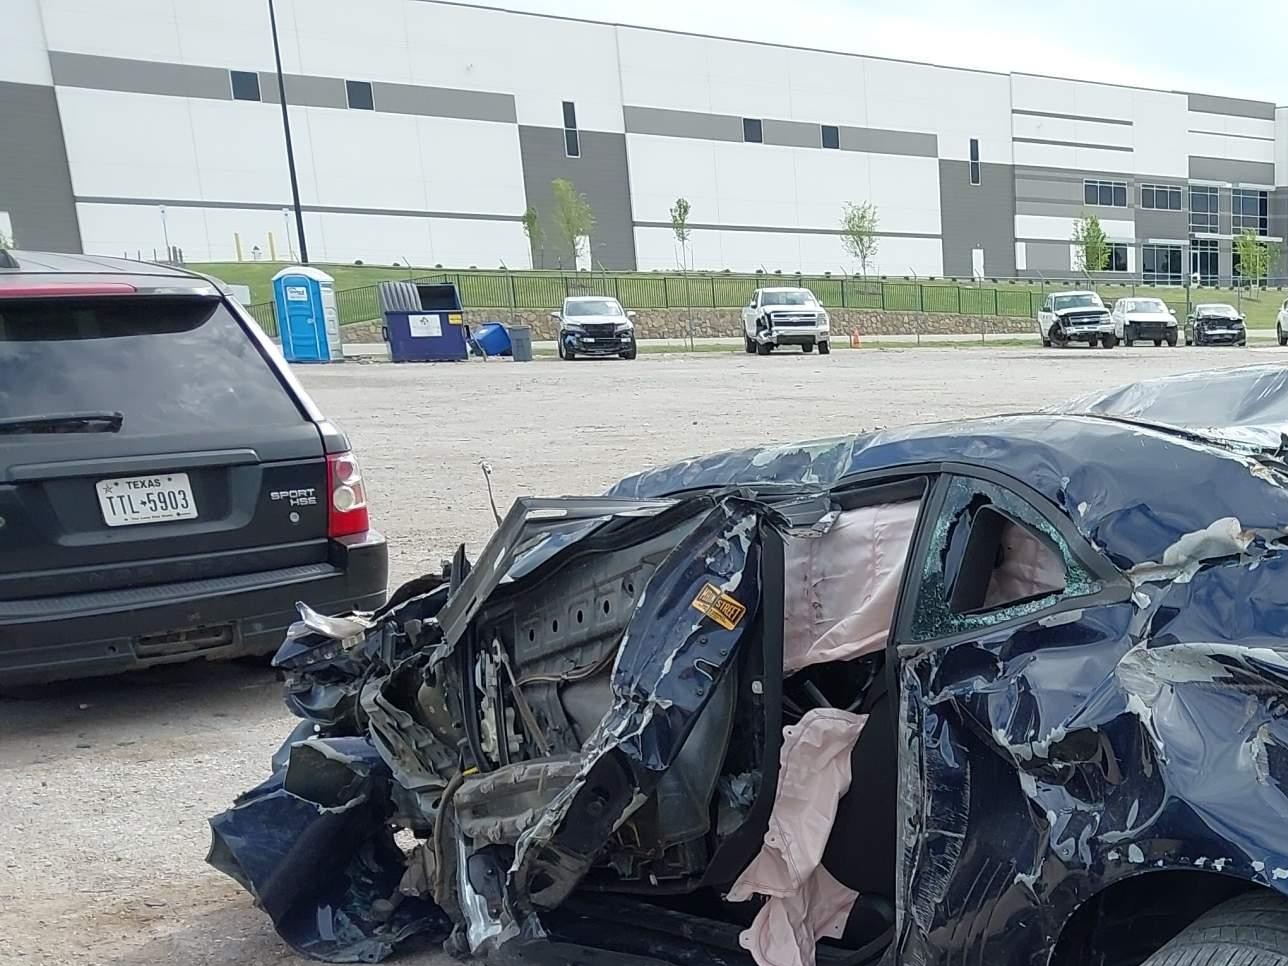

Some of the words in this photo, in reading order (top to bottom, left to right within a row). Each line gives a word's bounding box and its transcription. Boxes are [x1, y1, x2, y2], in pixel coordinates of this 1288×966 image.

[126, 478, 161, 490] TEXAS
[270, 488, 316, 500] SPORT
[290, 497, 317, 506] HSE
[715, 598, 741, 621] STREET
